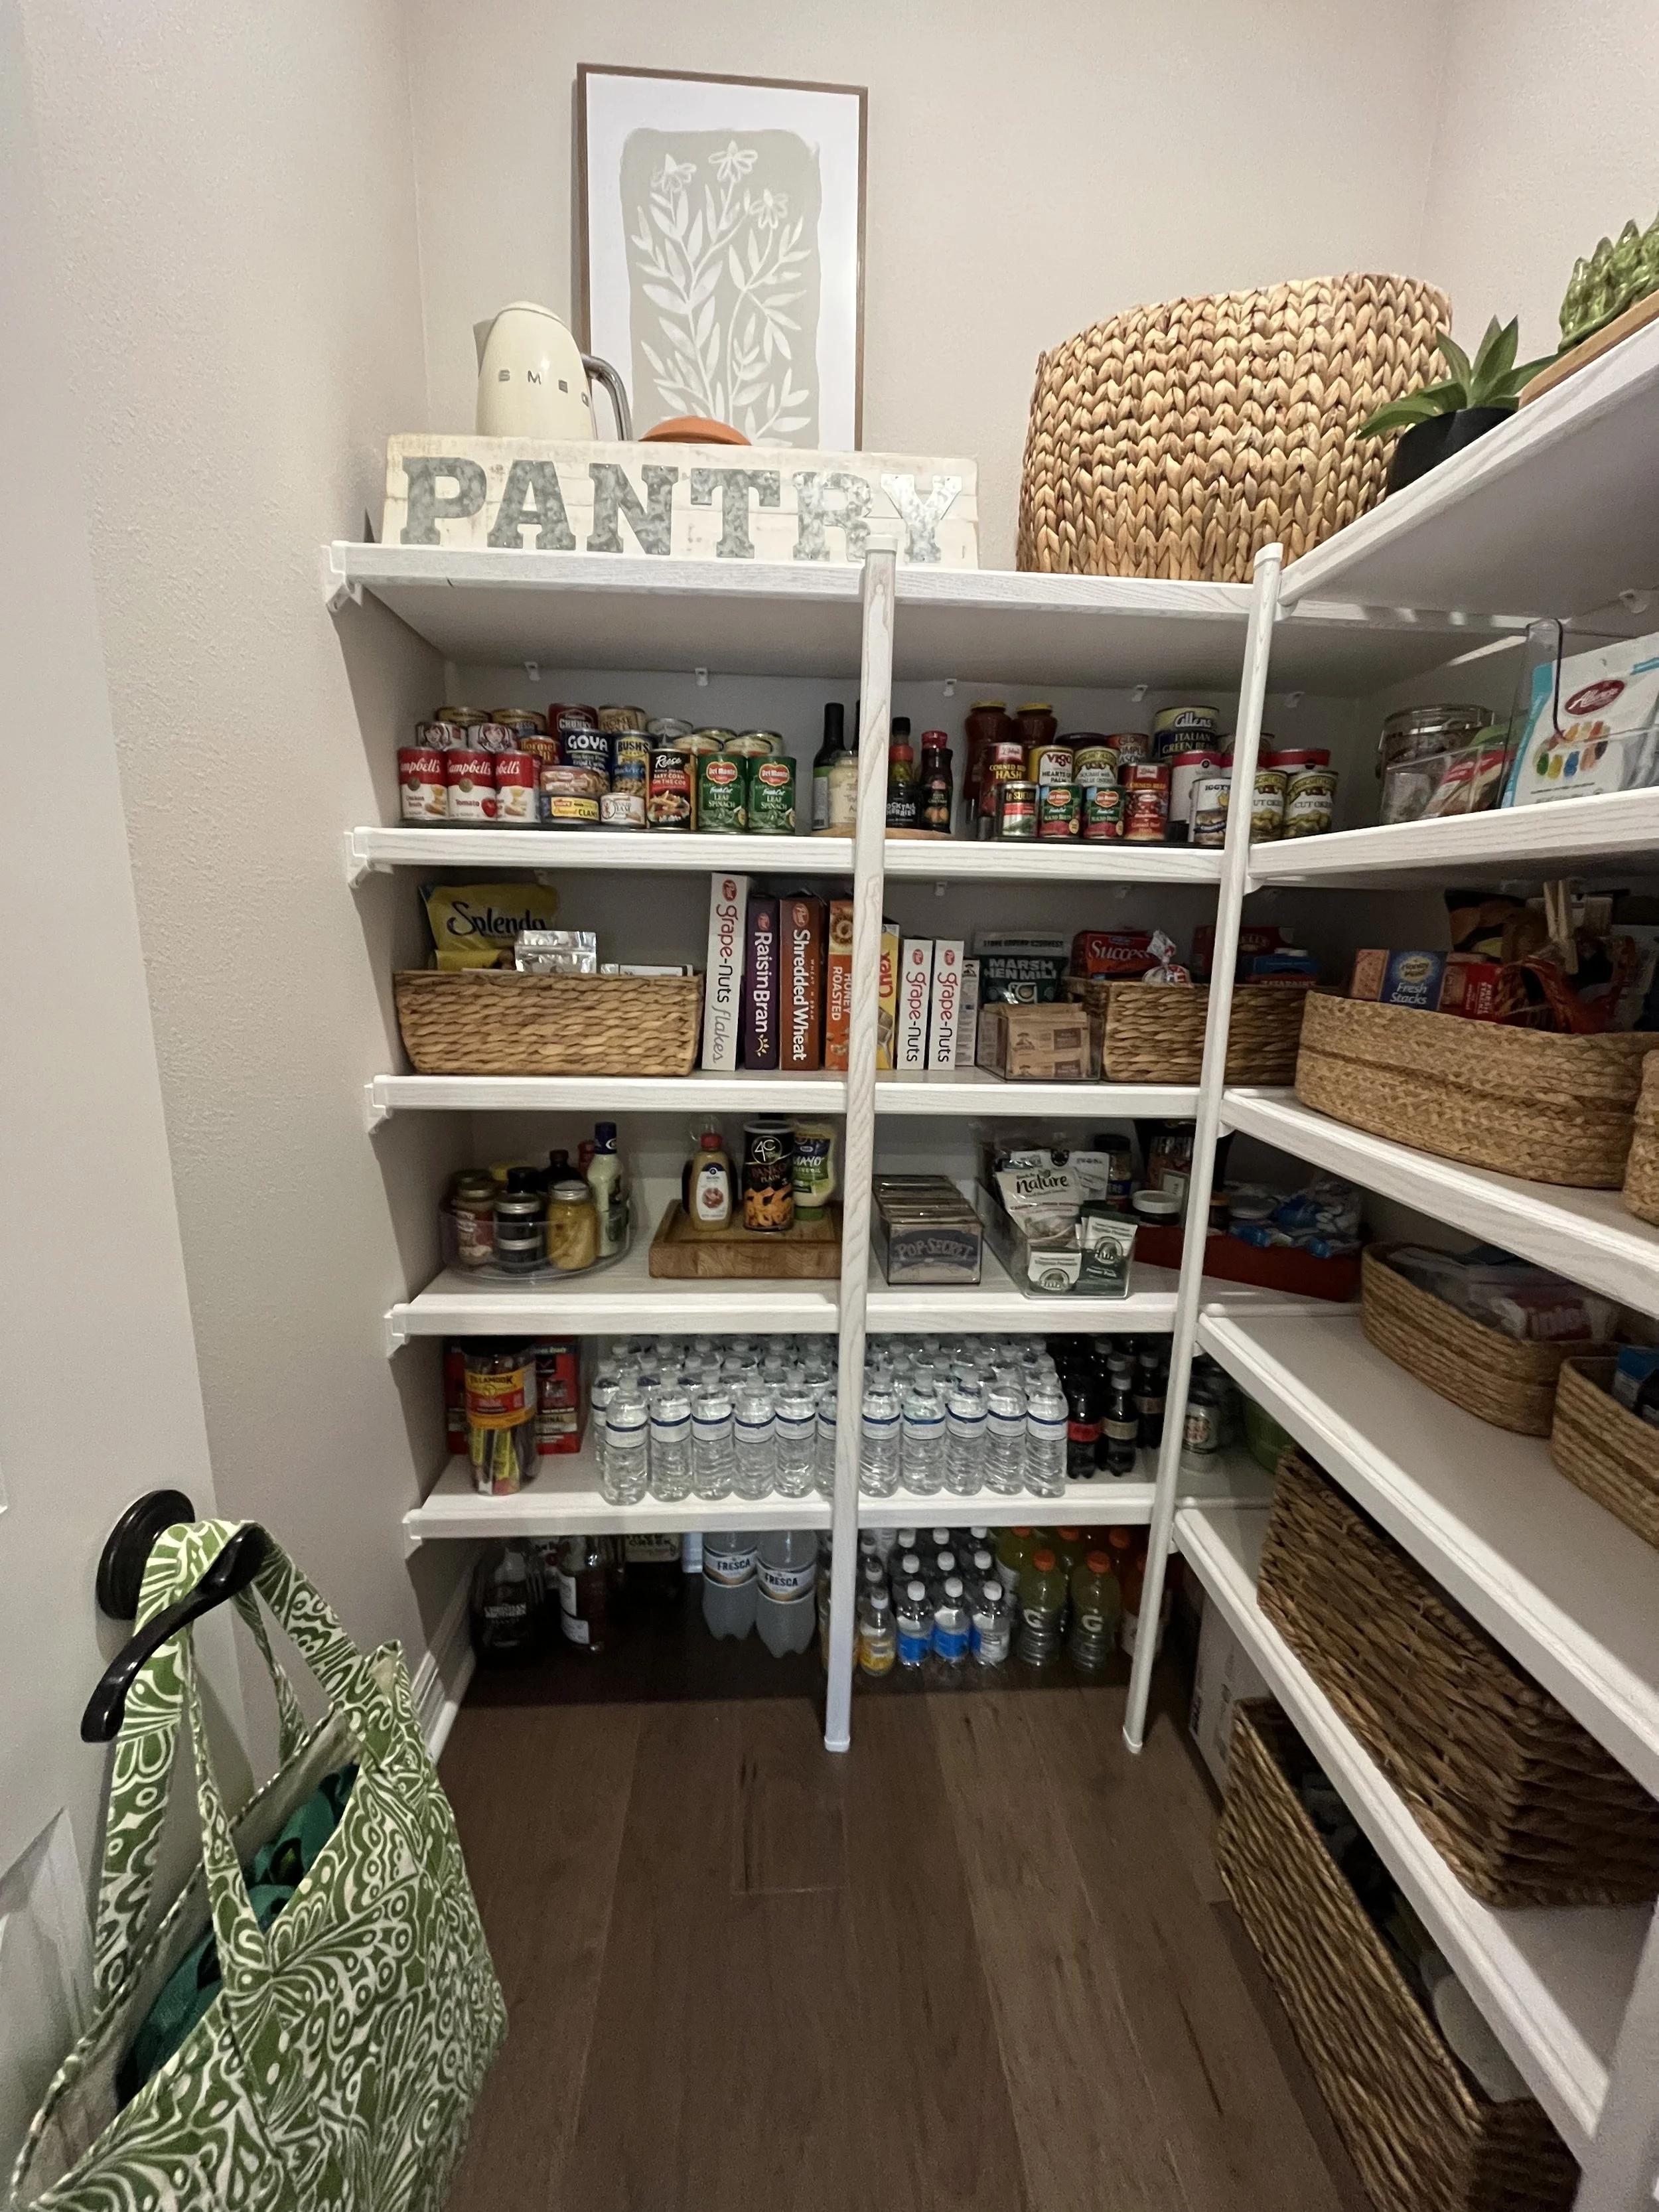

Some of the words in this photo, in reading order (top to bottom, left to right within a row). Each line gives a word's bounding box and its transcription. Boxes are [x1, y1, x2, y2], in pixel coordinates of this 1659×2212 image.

[399, 455, 963, 564] PANTRY
[567, 734, 609, 752] GOYA
[1175, 732, 1211, 741] ITALIAN
[617, 741, 650, 754] BUSH'S
[1163, 742, 1194, 755] GREEN
[400, 757, 441, 774] ampbell's
[448, 759, 492, 776] ampbell's
[654, 754, 682, 770] Reese
[995, 771, 1022, 780] HASH
[455, 798, 480, 807] Tomato
[708, 800, 736, 808] SPINACH
[887, 802, 916, 810] OCKTAIL
[447, 901, 547, 937] Splenda
[1088, 940, 1151, 962] Success
[754, 932, 773, 989] Raisin
[793, 929, 811, 1005] Shredded
[988, 958, 1054, 970] MARSH
[831, 966, 843, 1021] ROASTED
[1396, 982, 1427, 994] Fresh
[1390, 992, 1427, 1005] Stacks
[753, 990, 770, 1033] Bran
[906, 971, 927, 1063] grape-nuts
[937, 972, 959, 1063] grape-nuts
[711, 1004, 731, 1064] flakes
[793, 1005, 809, 1061] Wheat
[1016, 1173, 1069, 1194] nature
[717, 1558, 751, 1571] FRESCA
[764, 1572, 798, 1587] FRESCA
[1082, 1613, 1103, 1632] G
